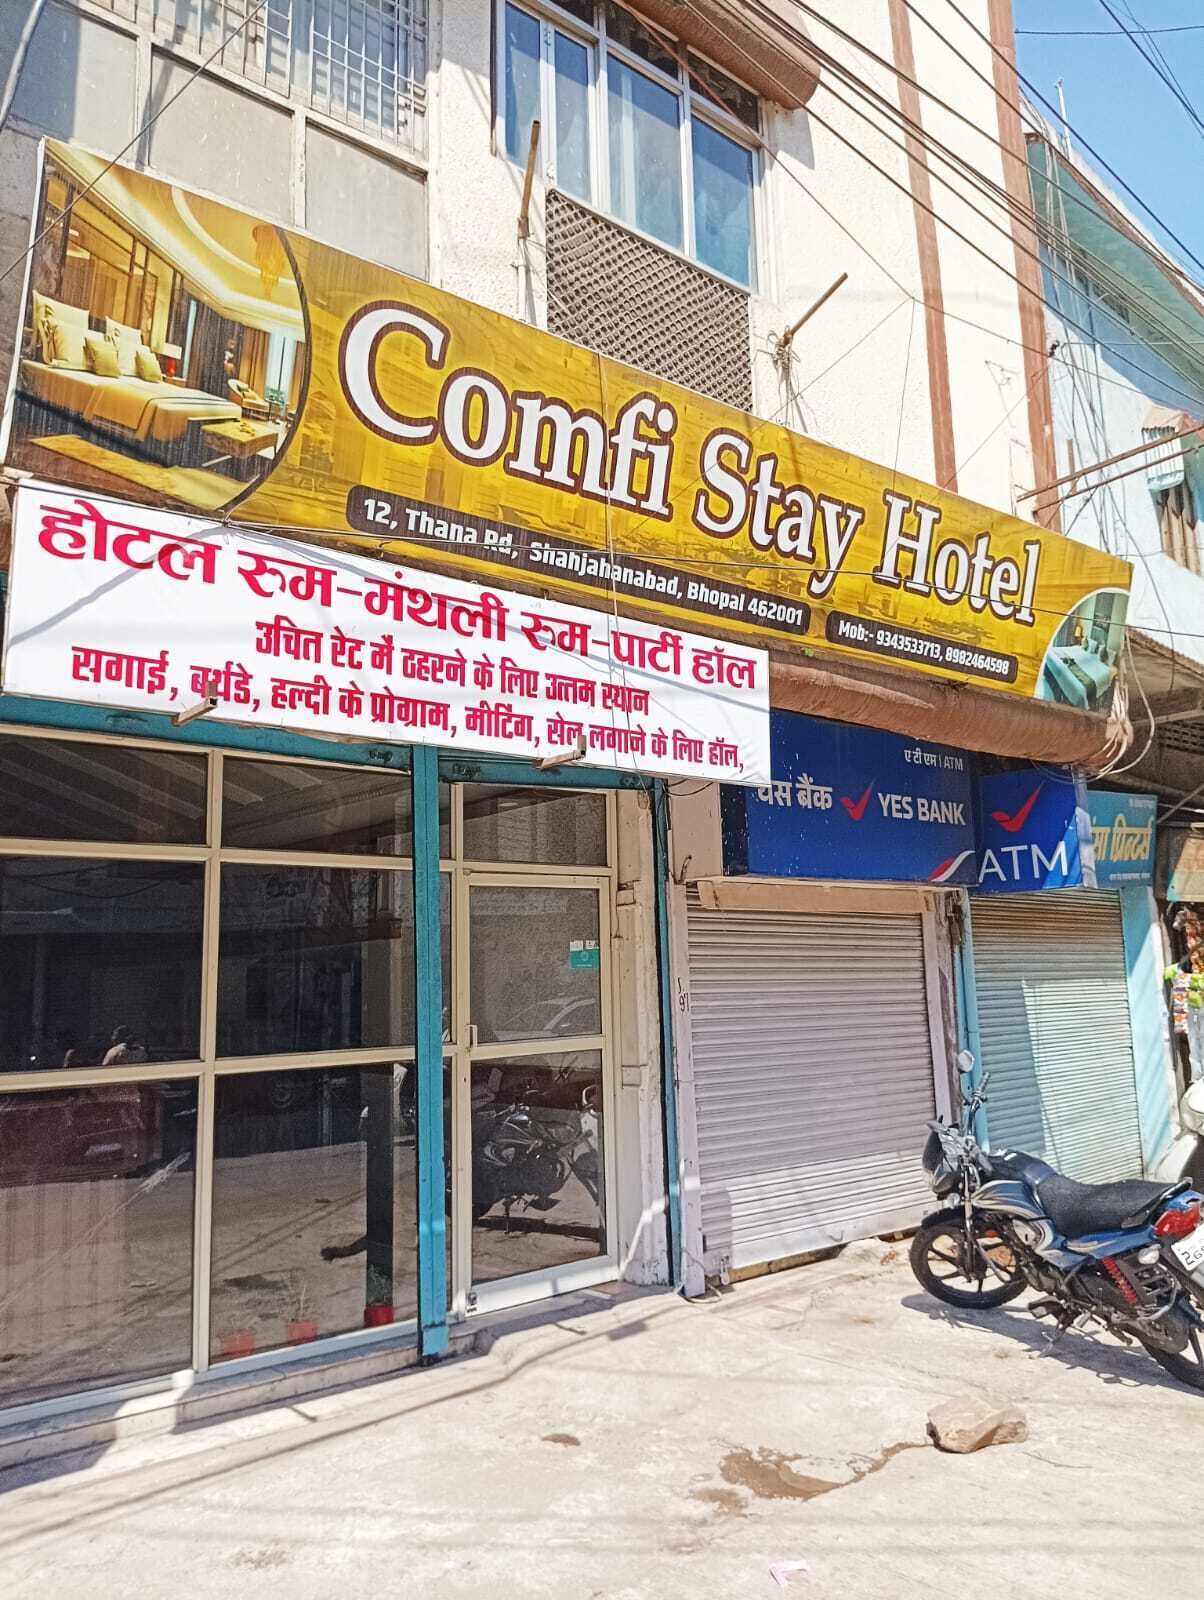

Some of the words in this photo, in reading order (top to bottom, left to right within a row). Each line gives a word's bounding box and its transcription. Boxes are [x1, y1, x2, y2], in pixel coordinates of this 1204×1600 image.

[339, 301, 675, 521] Comfi
[693, 428, 864, 598] Stay
[873, 489, 1041, 625] Hotel
[38, 499, 221, 585] होटल
[692, 646, 757, 689] हॉल
[363, 499, 398, 530] 12,
[406, 508, 477, 545] Thana
[484, 529, 518, 559] Rd,
[529, 541, 682, 599] Shahjahanabad,
[687, 582, 745, 612] Bhopal
[747, 597, 803, 626] 462001
[255, 614, 323, 664] उचित
[330, 625, 366, 670] रेट
[473, 653, 494, 690] के
[499, 656, 540, 698] लिए
[545, 673, 597, 707] उत्तम
[601, 682, 650, 716] स्थान
[838, 620, 874, 643] Mob:-
[876, 630, 943, 661] 9343533713,
[945, 647, 1010, 675] 8982464598
[71, 646, 178, 701] सगाई,
[271, 674, 332, 715] हल्दी
[338, 680, 364, 718] के
[370, 686, 457, 738] प्रोग्राम,
[465, 700, 540, 749] मीटिंग,
[589, 724, 646, 756] लगाने
[651, 727, 669, 758] के
[673, 729, 704, 763] लिए
[709, 736, 745, 774] हॉल,
[796, 772, 833, 810] बैंक
[944, 756, 964, 771] ATM
[878, 792, 913, 820] YES
[917, 798, 966, 826] BANK
[978, 841, 1068, 883] ATM
